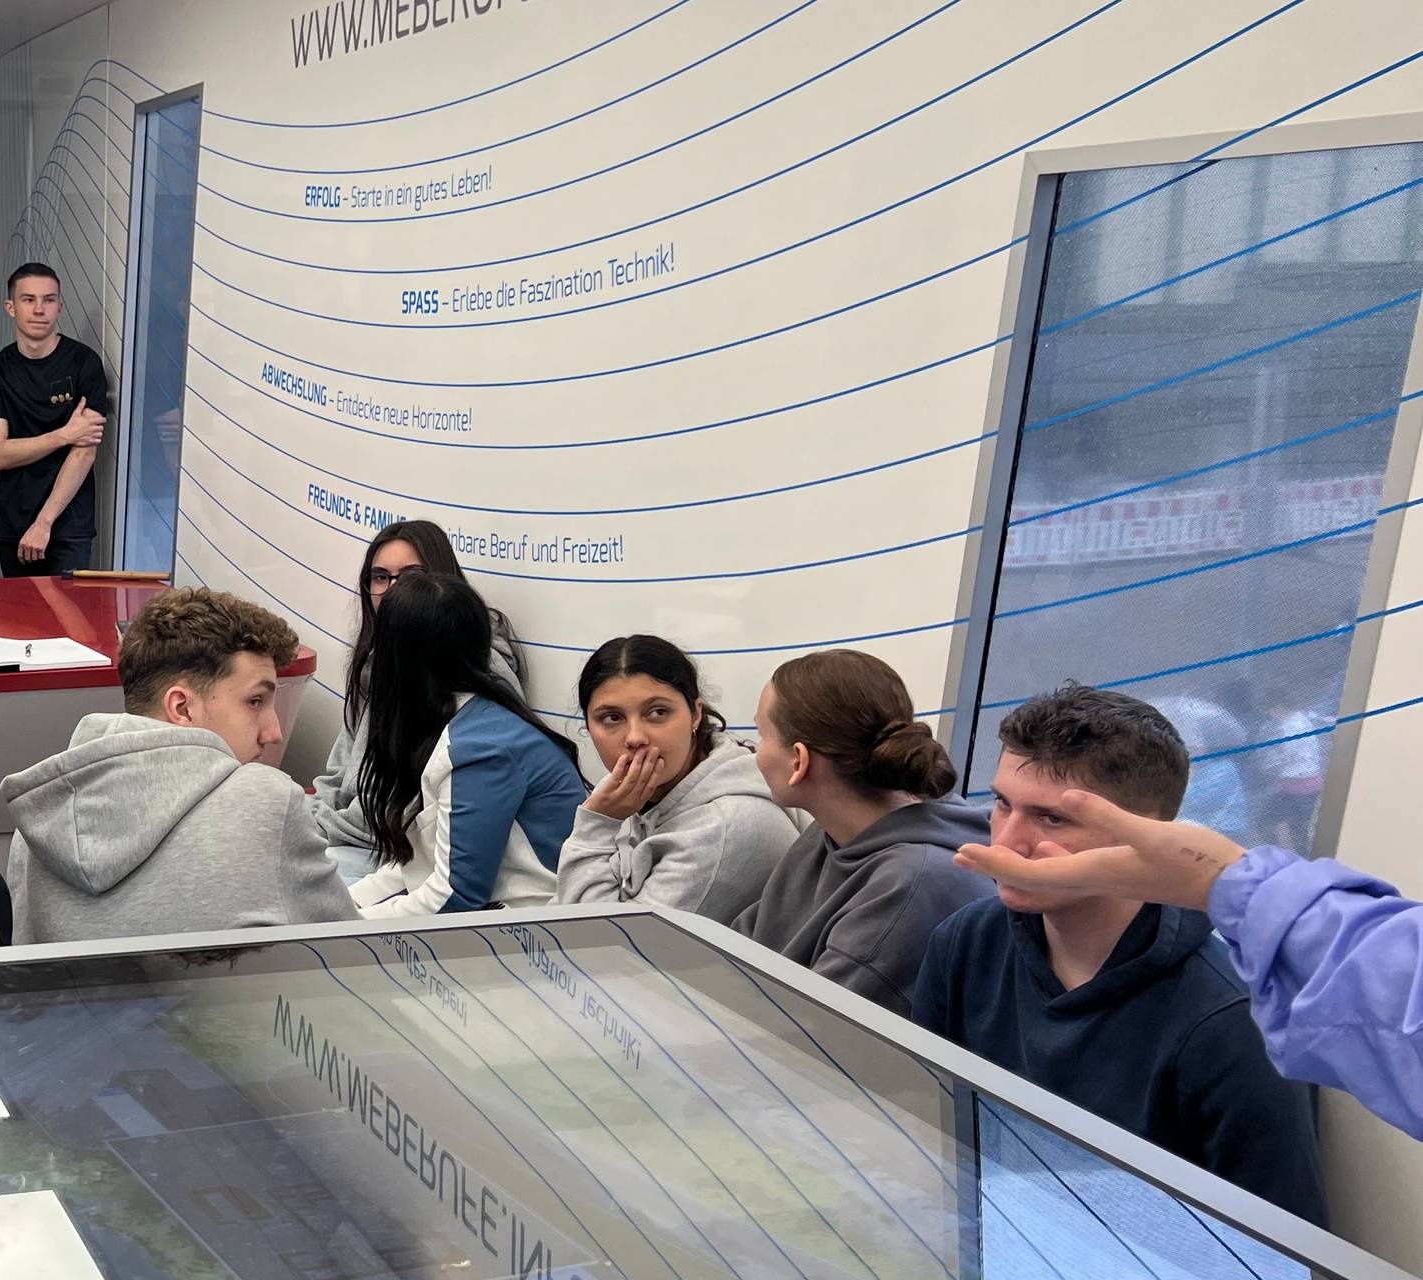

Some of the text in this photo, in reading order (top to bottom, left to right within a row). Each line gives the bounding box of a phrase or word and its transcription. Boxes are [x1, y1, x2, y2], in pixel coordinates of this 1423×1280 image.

[291, 0, 528, 68] WWW.MEB
[305, 185, 341, 208] ERFOLG
[351, 185, 382, 208] Starte
[384, 184, 394, 206] in
[396, 183, 411, 205] ein
[414, 179, 448, 211] gutes
[451, 164, 492, 198] Leben!
[401, 290, 439, 314] SPASS
[452, 284, 492, 312] Erlebe
[496, 281, 515, 308] die
[519, 268, 602, 305] Faszination
[608, 242, 675, 288] Technik!
[261, 362, 327, 406] ABWECHSLUNG
[337, 391, 380, 422] Entdecke
[383, 405, 409, 427] neue
[412, 404, 473, 432] Horizonte!
[307, 483, 624, 564] FREUNDE & FAMI inbare Beruf und Freizeit!
